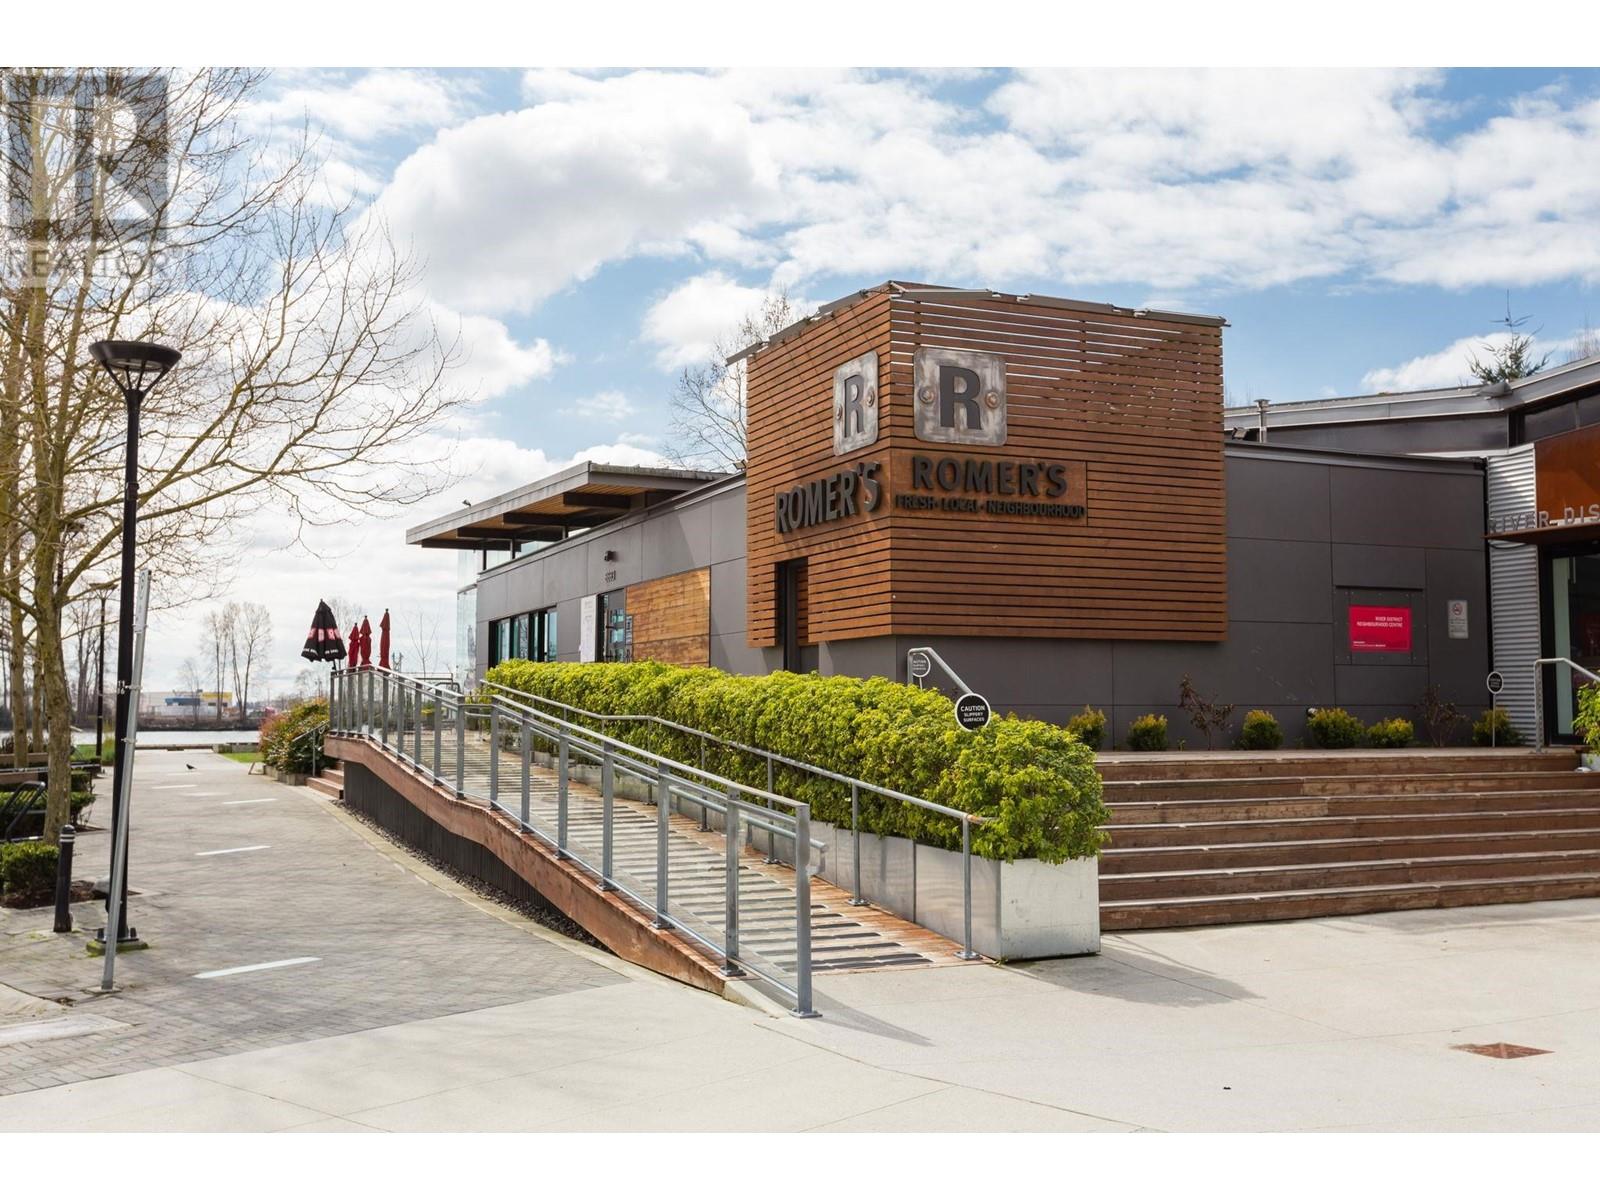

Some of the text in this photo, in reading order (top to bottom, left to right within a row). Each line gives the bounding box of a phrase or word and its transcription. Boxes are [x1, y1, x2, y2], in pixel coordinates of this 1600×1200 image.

[843, 374, 865, 438] R
[938, 365, 983, 430] R
[775, 461, 881, 534] ROMER'S
[912, 456, 1068, 498] ROMER'S
[896, 494, 1087, 519] FRESH LOCAL NEIGHBOURHOOD
[1488, 510, 1550, 533] RIVER
